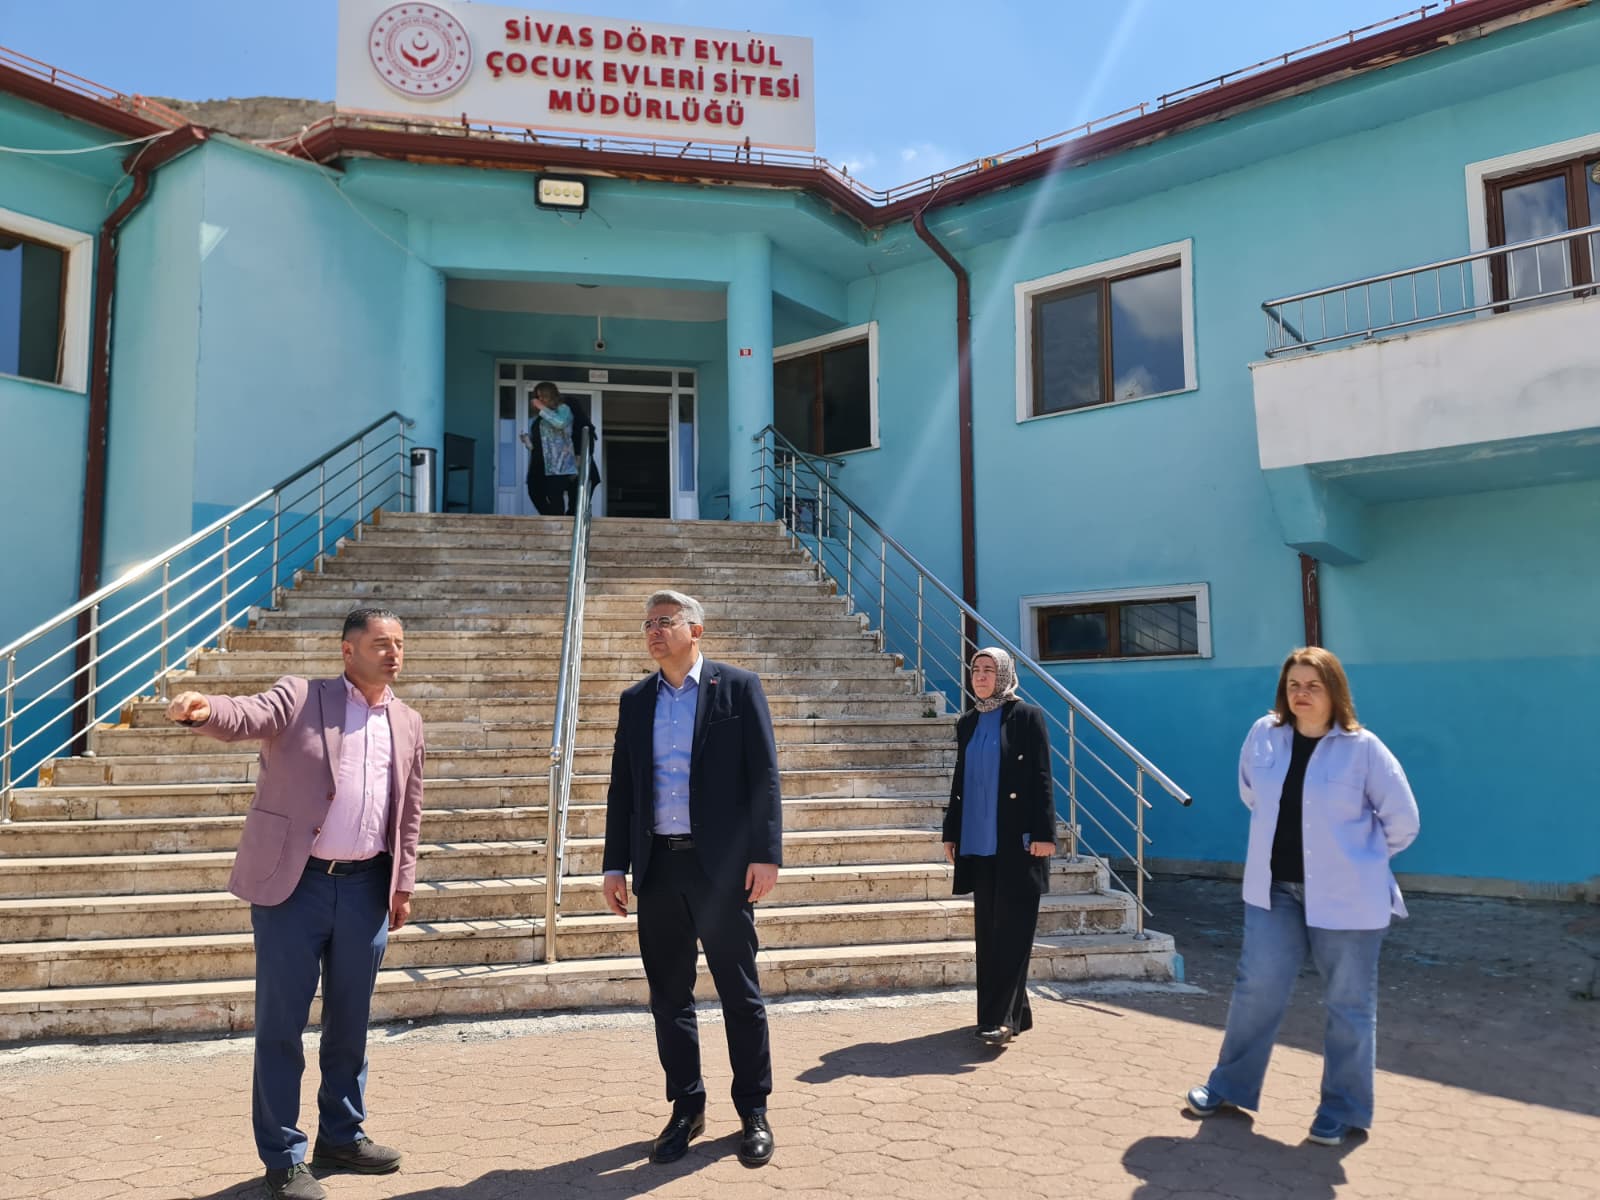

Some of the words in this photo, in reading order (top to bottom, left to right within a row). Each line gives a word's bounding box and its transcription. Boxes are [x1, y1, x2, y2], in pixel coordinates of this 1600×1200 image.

[505, 16, 594, 48] SİVAS
[604, 26, 686, 57] DÖRT
[694, 39, 783, 67] EYLÜL
[486, 51, 593, 81] ÇOCUK
[603, 62, 704, 91] EVLERİ
[713, 70, 800, 99] SİTESİ
[548, 89, 744, 127] MÜDÜRLÜĞÜ
